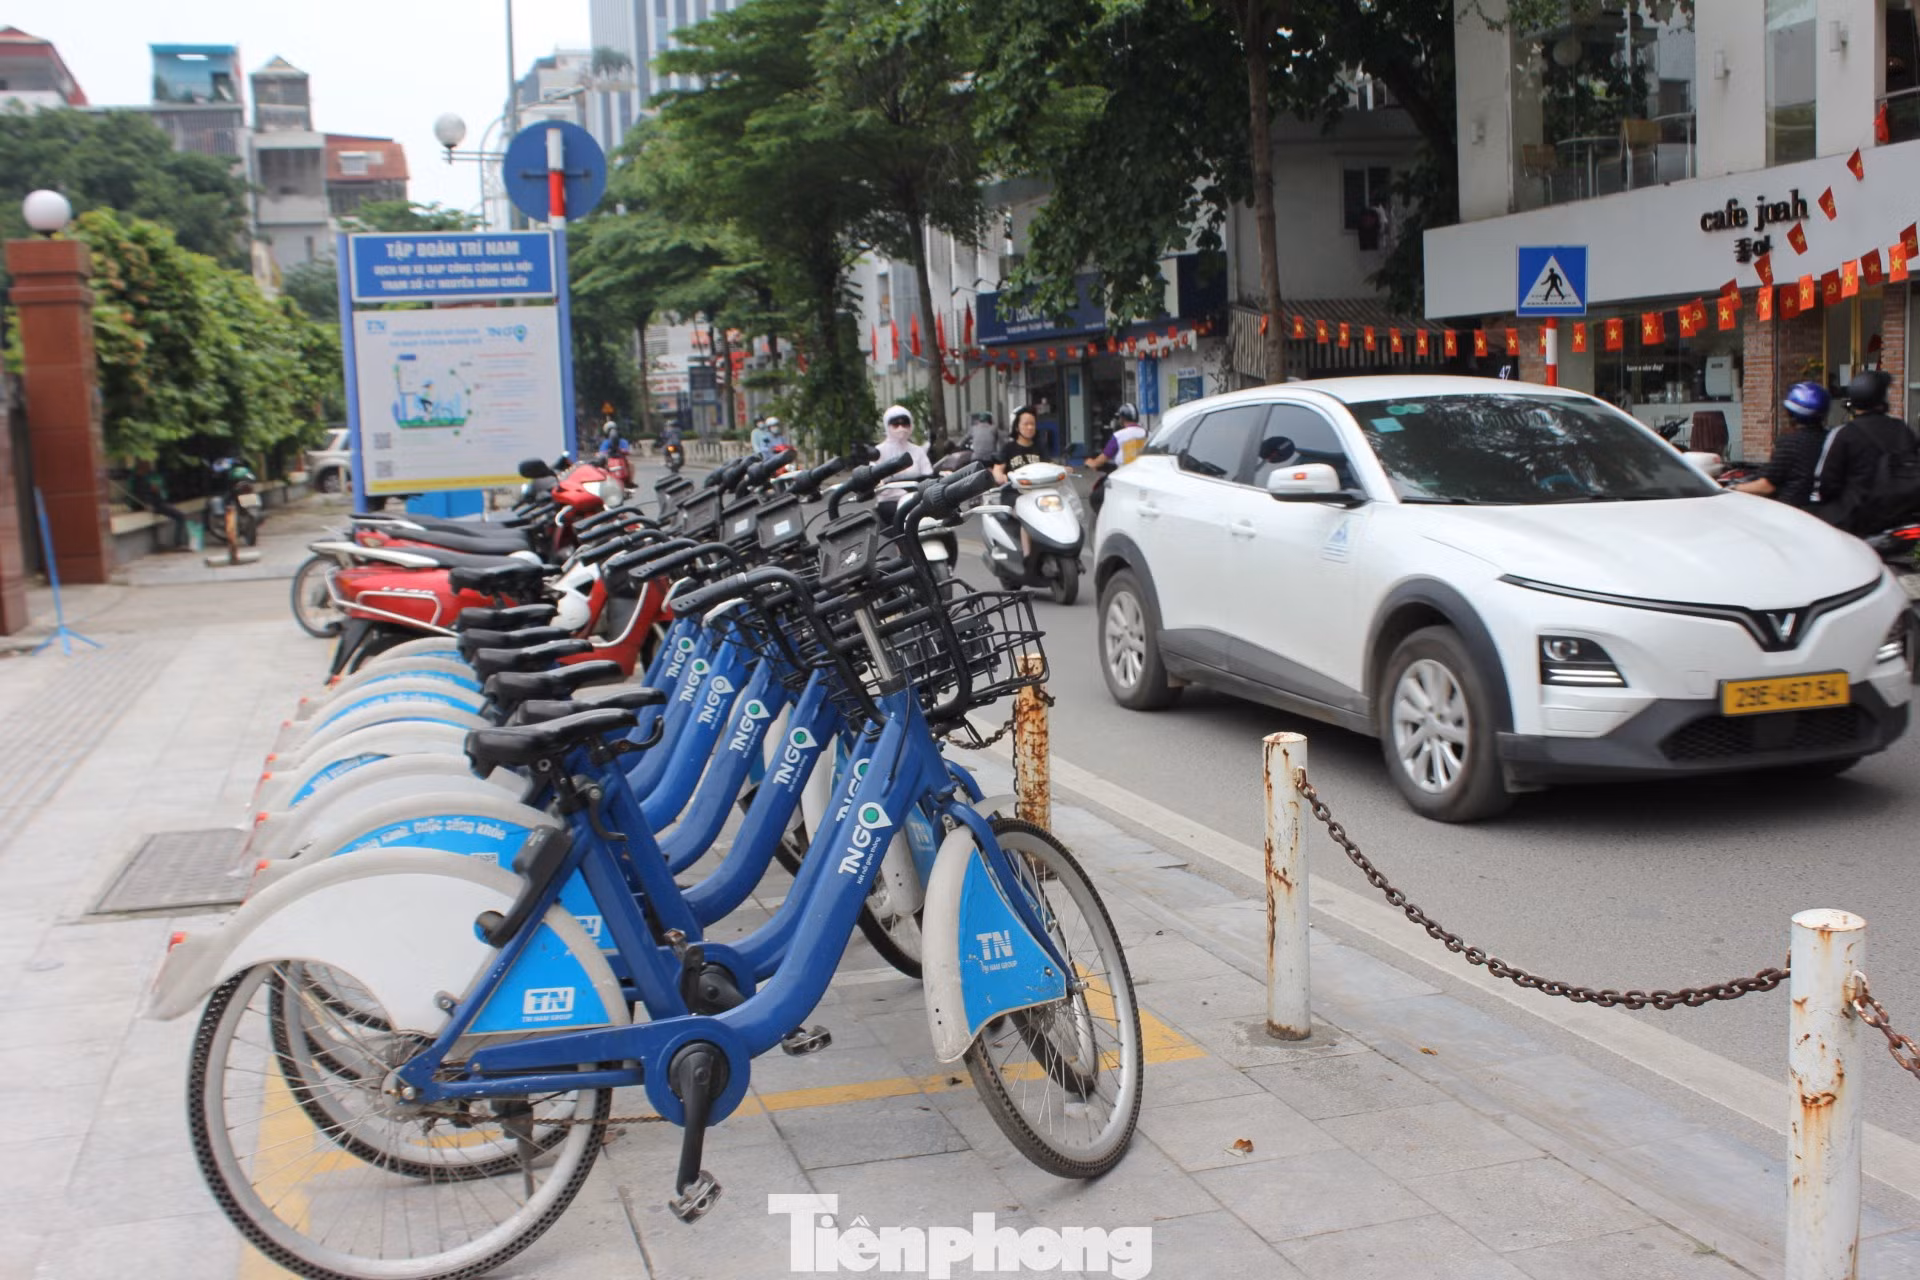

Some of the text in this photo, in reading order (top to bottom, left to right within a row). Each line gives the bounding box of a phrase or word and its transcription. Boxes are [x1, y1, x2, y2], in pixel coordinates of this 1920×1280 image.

[1700, 188, 1810, 232] cafe joah
[385, 240, 414, 260] TẬP
[416, 240, 457, 258] ĐOÀN
[485, 241, 520, 256] NAM
[838, 802, 893, 875] TNGO
[976, 930, 1013, 960] TN
[528, 989, 571, 1011] TN
